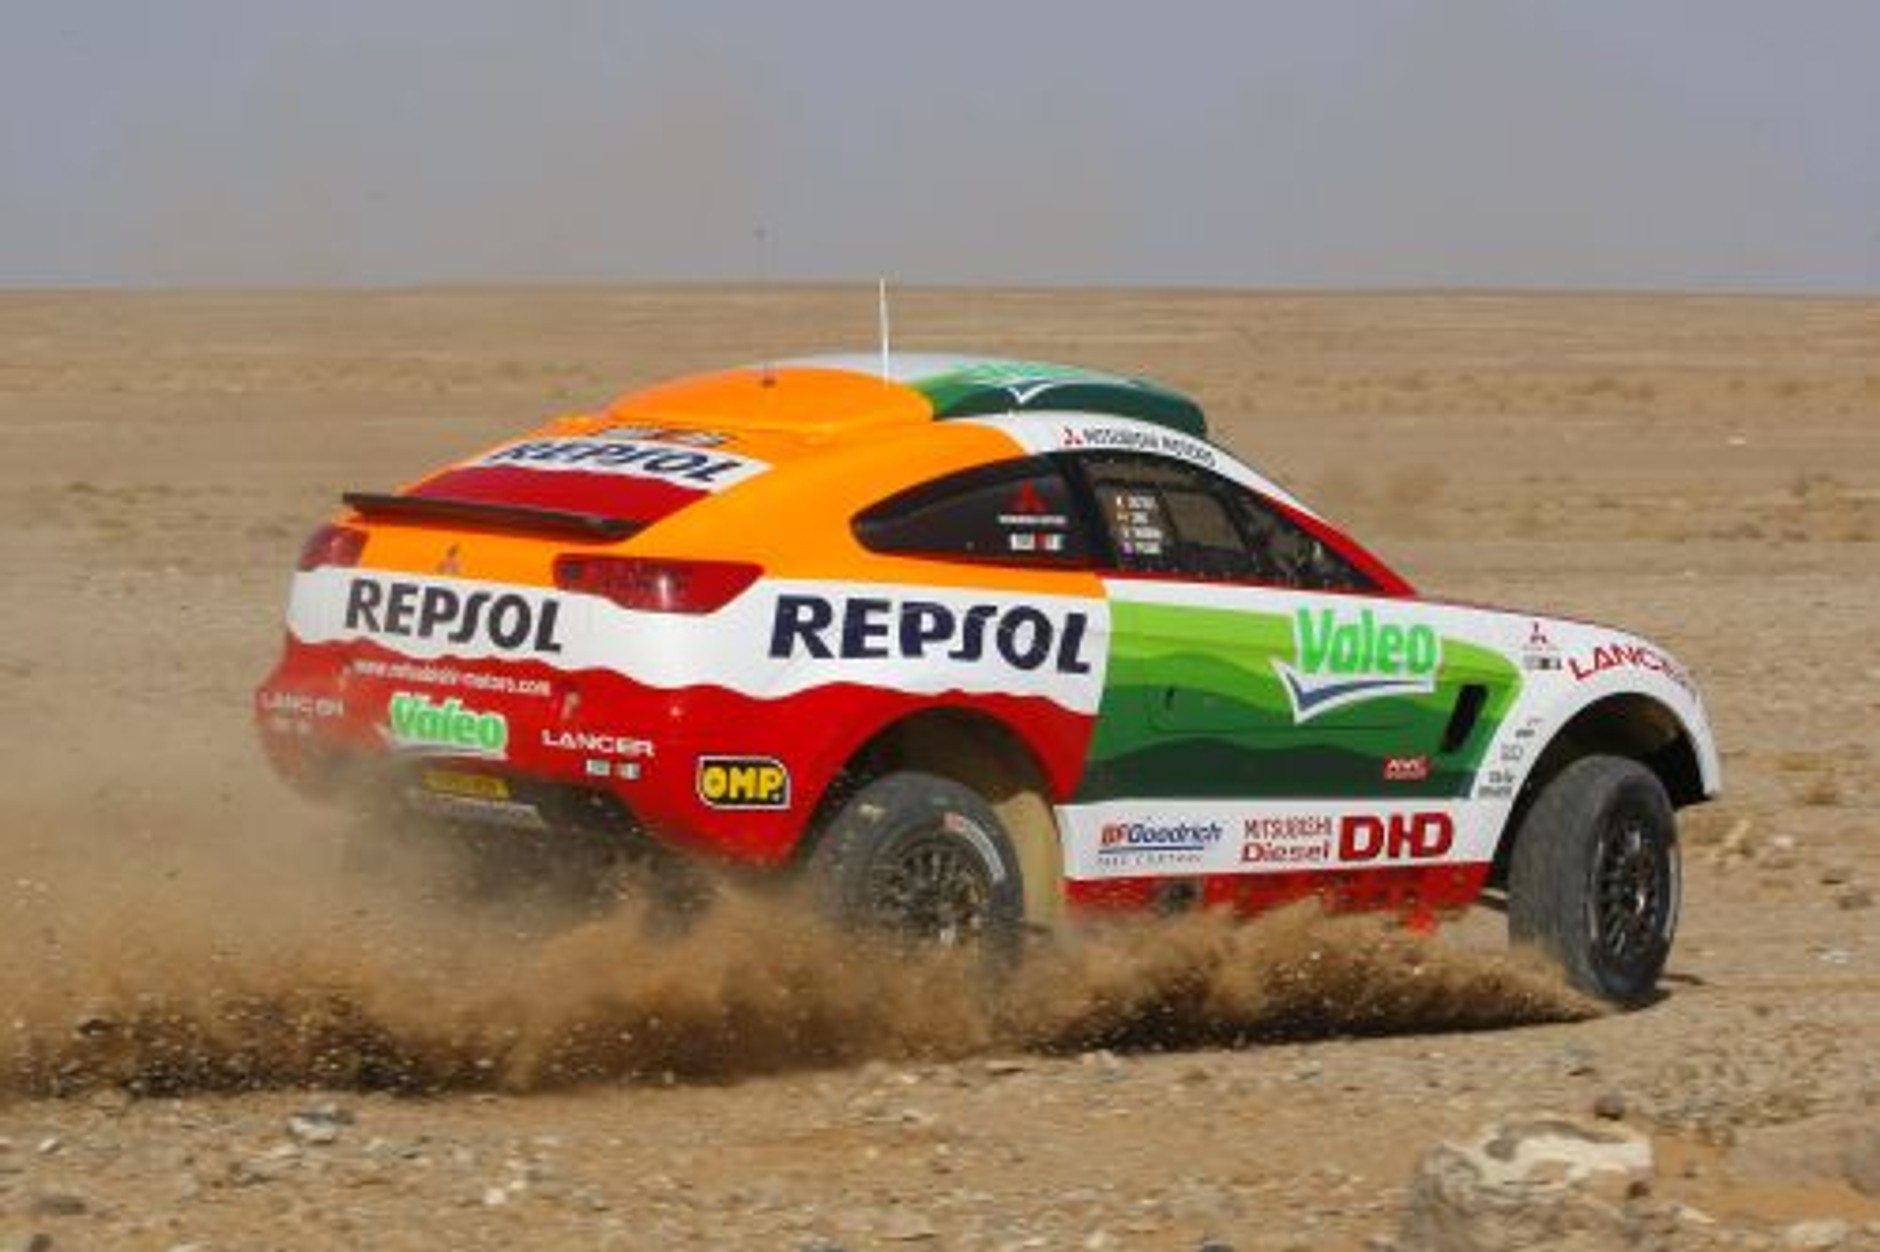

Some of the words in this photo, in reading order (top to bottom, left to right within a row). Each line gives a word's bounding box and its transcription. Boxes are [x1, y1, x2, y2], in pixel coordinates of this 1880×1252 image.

[490, 440, 742, 484] REPSOL
[345, 577, 563, 653] REPSOL
[769, 594, 1091, 674] REPSOL
[1294, 606, 1440, 676] Valeo
[1567, 643, 1690, 682] LANC
[389, 692, 508, 752] Valeo
[541, 729, 656, 758] LANCER
[702, 765, 784, 800] OMP
[1244, 815, 1332, 840] MITSUBISHI
[1241, 840, 1330, 863] Diesel
